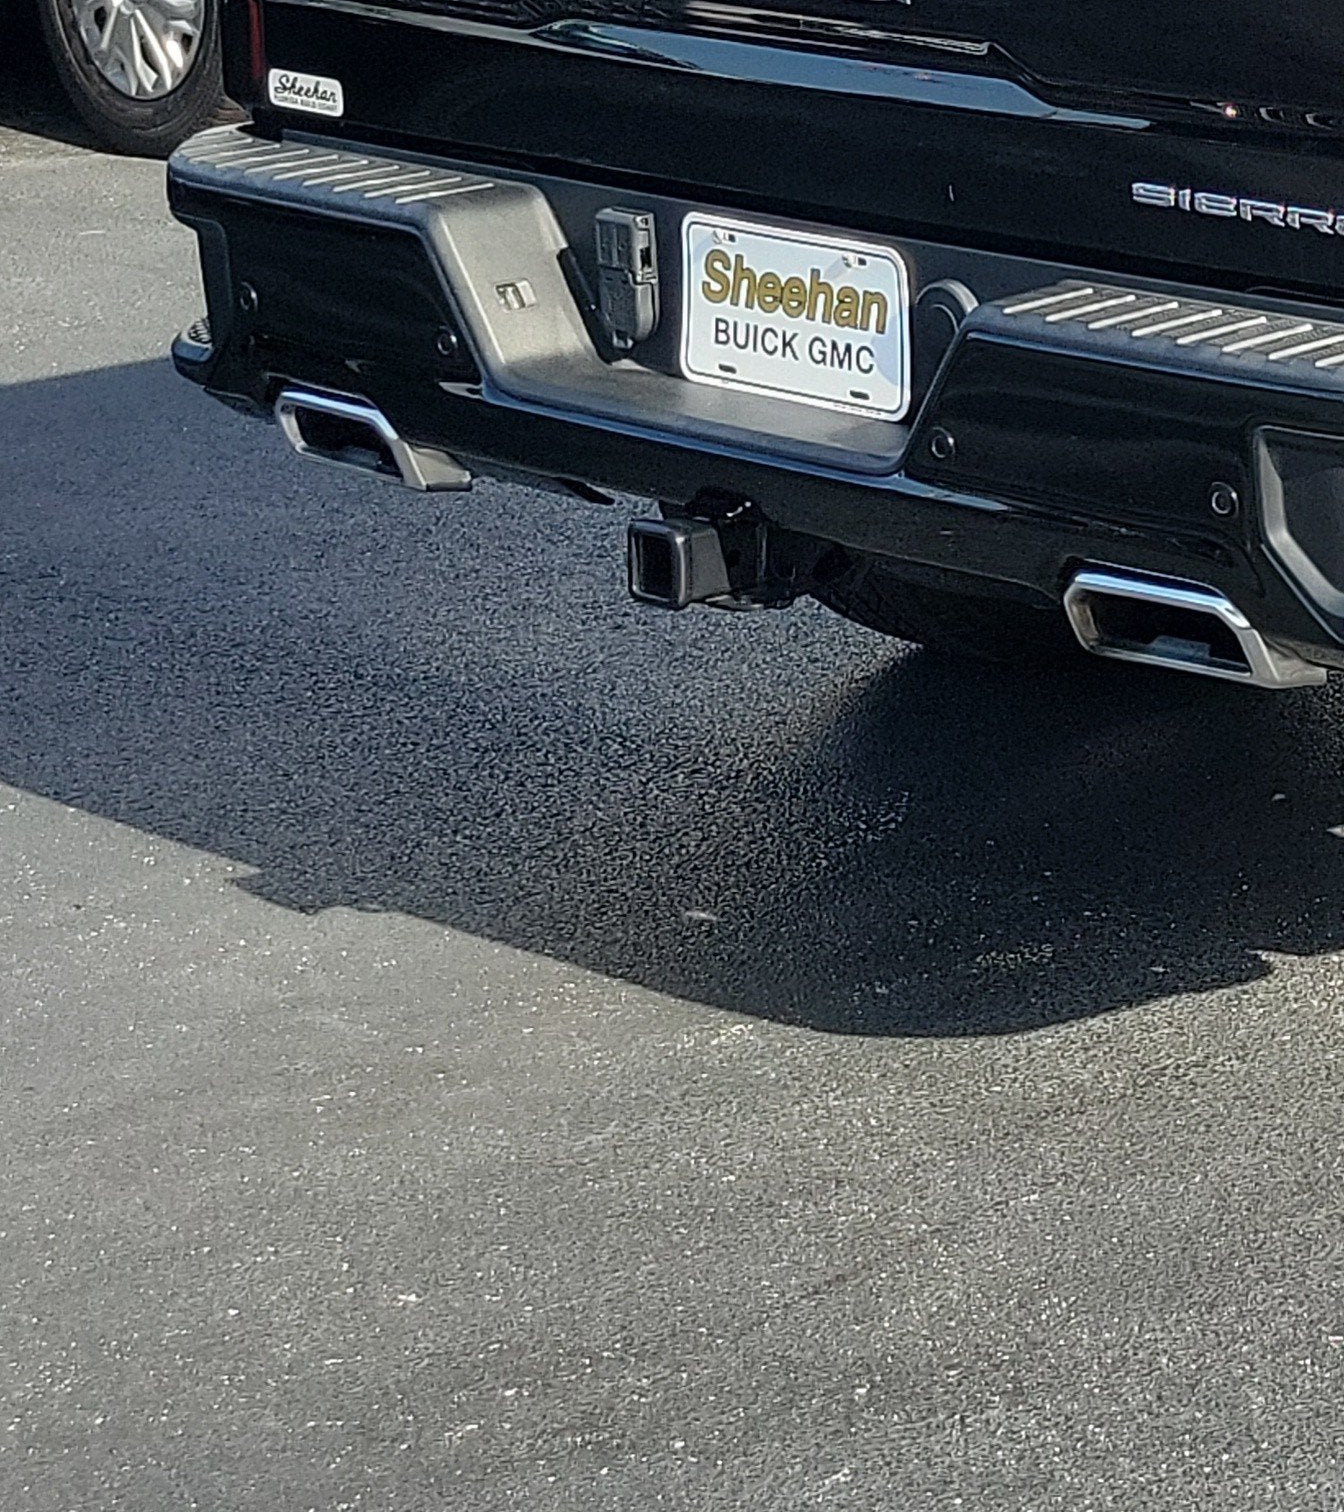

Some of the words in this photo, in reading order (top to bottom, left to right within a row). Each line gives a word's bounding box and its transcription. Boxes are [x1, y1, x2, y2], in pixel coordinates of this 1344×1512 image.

[274, 74, 337, 103] Sheehan
[702, 248, 888, 334] Sheehan
[714, 317, 799, 361] BUICK
[808, 336, 874, 374] GMC
